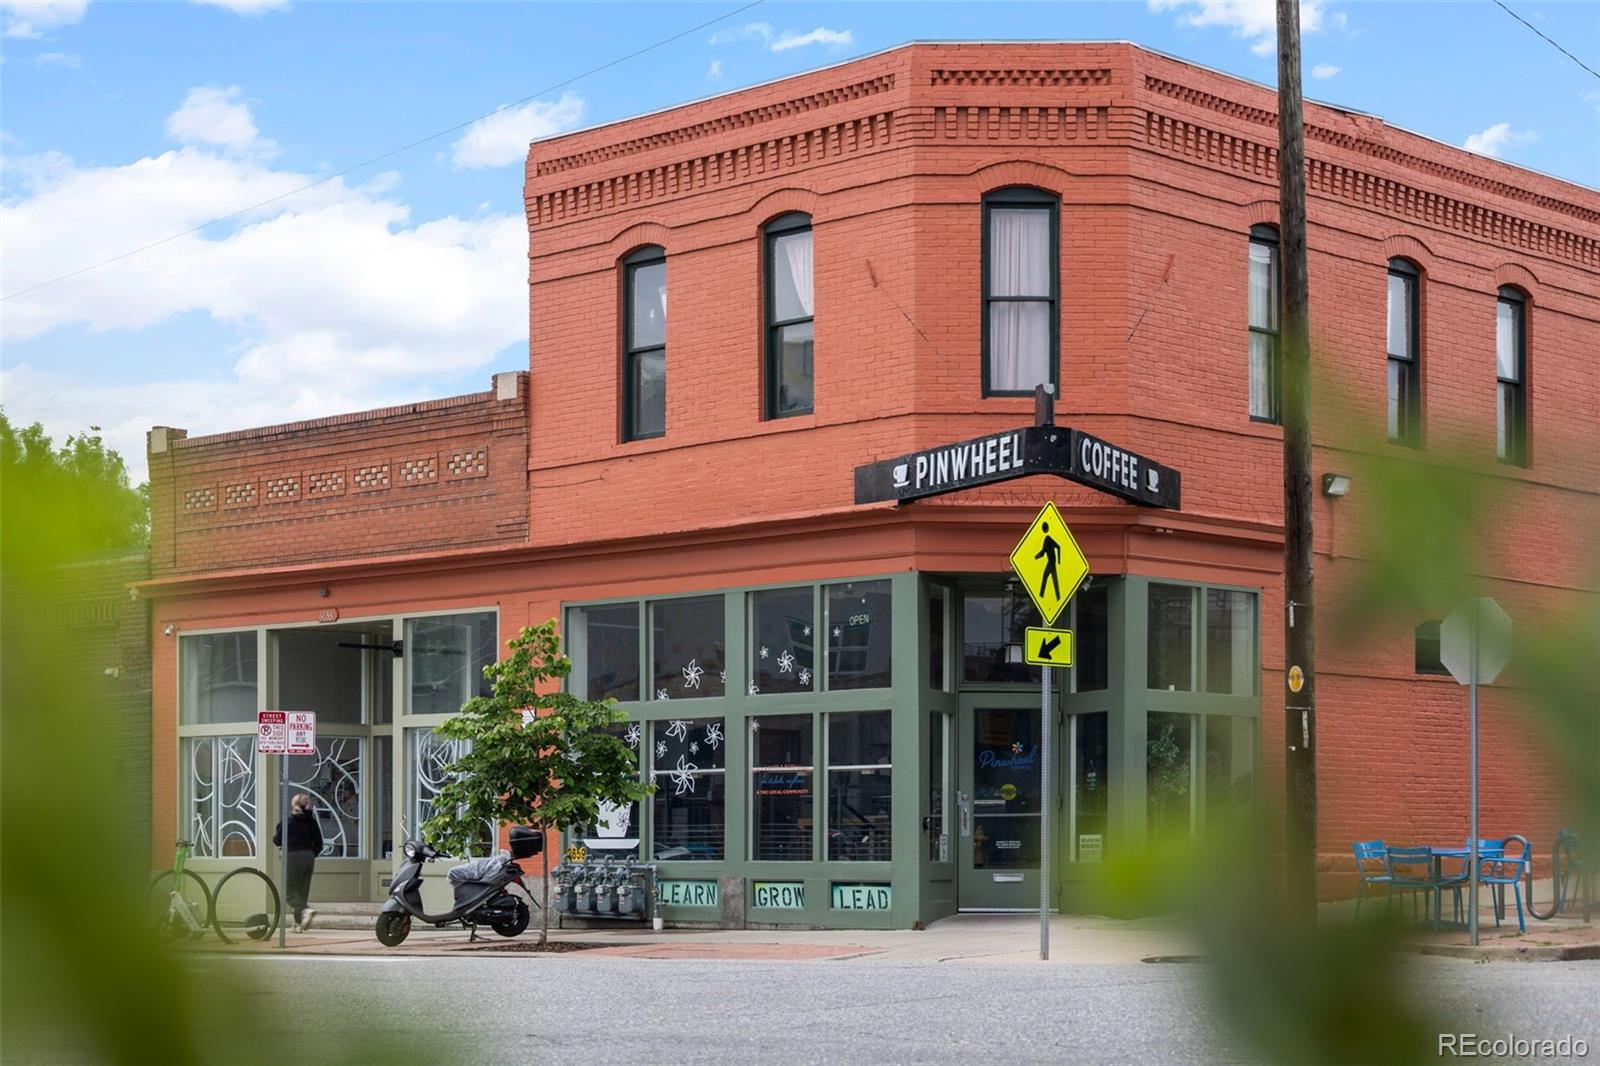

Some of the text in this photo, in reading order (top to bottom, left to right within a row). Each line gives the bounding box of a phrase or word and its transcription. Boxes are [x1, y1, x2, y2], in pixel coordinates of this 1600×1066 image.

[916, 433, 1024, 489] PINWHEEL
[1081, 437, 1138, 491] COFFEE
[849, 614, 870, 626] OPEN
[289, 722, 313, 731] PARKING
[296, 714, 307, 723] NO
[660, 883, 716, 905] LEARN
[757, 886, 804, 907] GROW
[840, 889, 889, 910] LEAD
